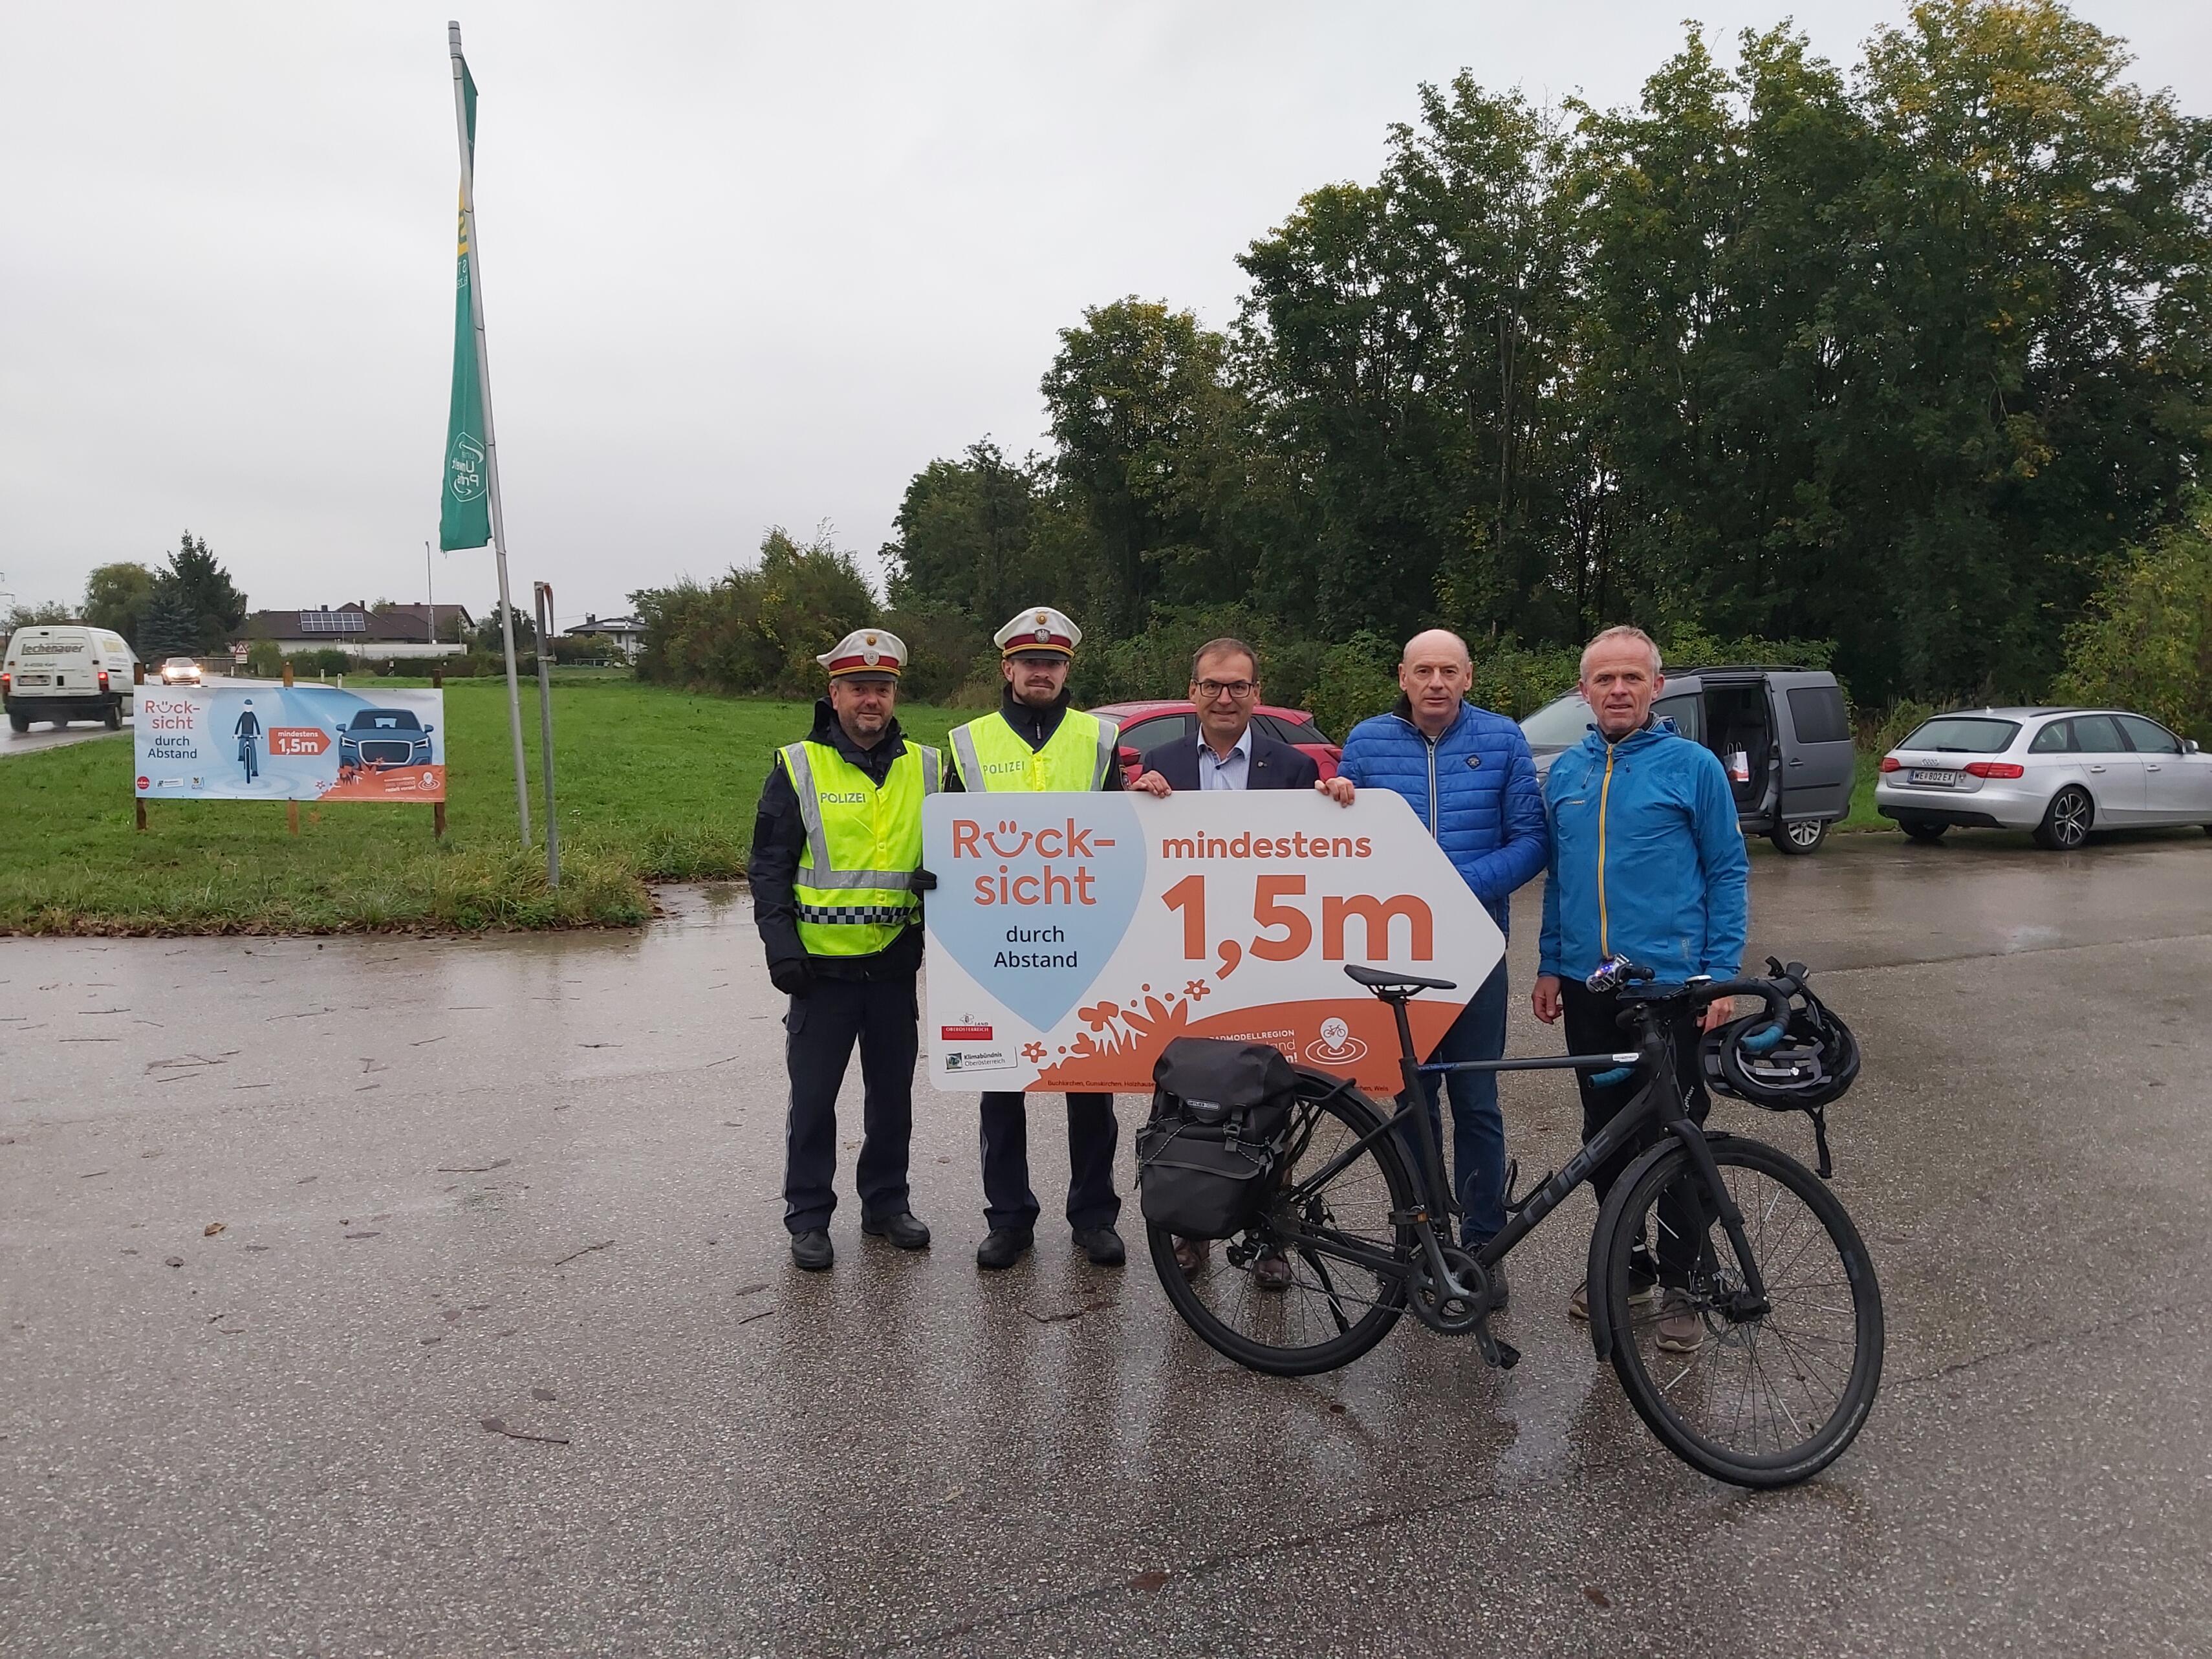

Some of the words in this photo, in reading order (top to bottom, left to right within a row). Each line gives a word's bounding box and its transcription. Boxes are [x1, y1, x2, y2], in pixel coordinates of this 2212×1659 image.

[152, 715, 193, 729] sicht
[155, 735, 190, 746] durch
[278, 738, 318, 755] 1,5m
[147, 748, 197, 759] Abstand
[983, 761, 1025, 775] POLIZEI
[1914, 771, 1924, 780] WE
[820, 792, 867, 803] POLIZEI
[953, 819, 1114, 858] Rück-
[1162, 831, 1371, 858] mindestens
[975, 866, 1094, 905] sicht
[1162, 874, 1433, 980] 1,5m
[1006, 926, 1065, 943] durch
[994, 950, 1078, 968] Abstand
[964, 1051, 1003, 1061] Klimabündnis
[964, 1058, 1006, 1067] Oberösterreich
